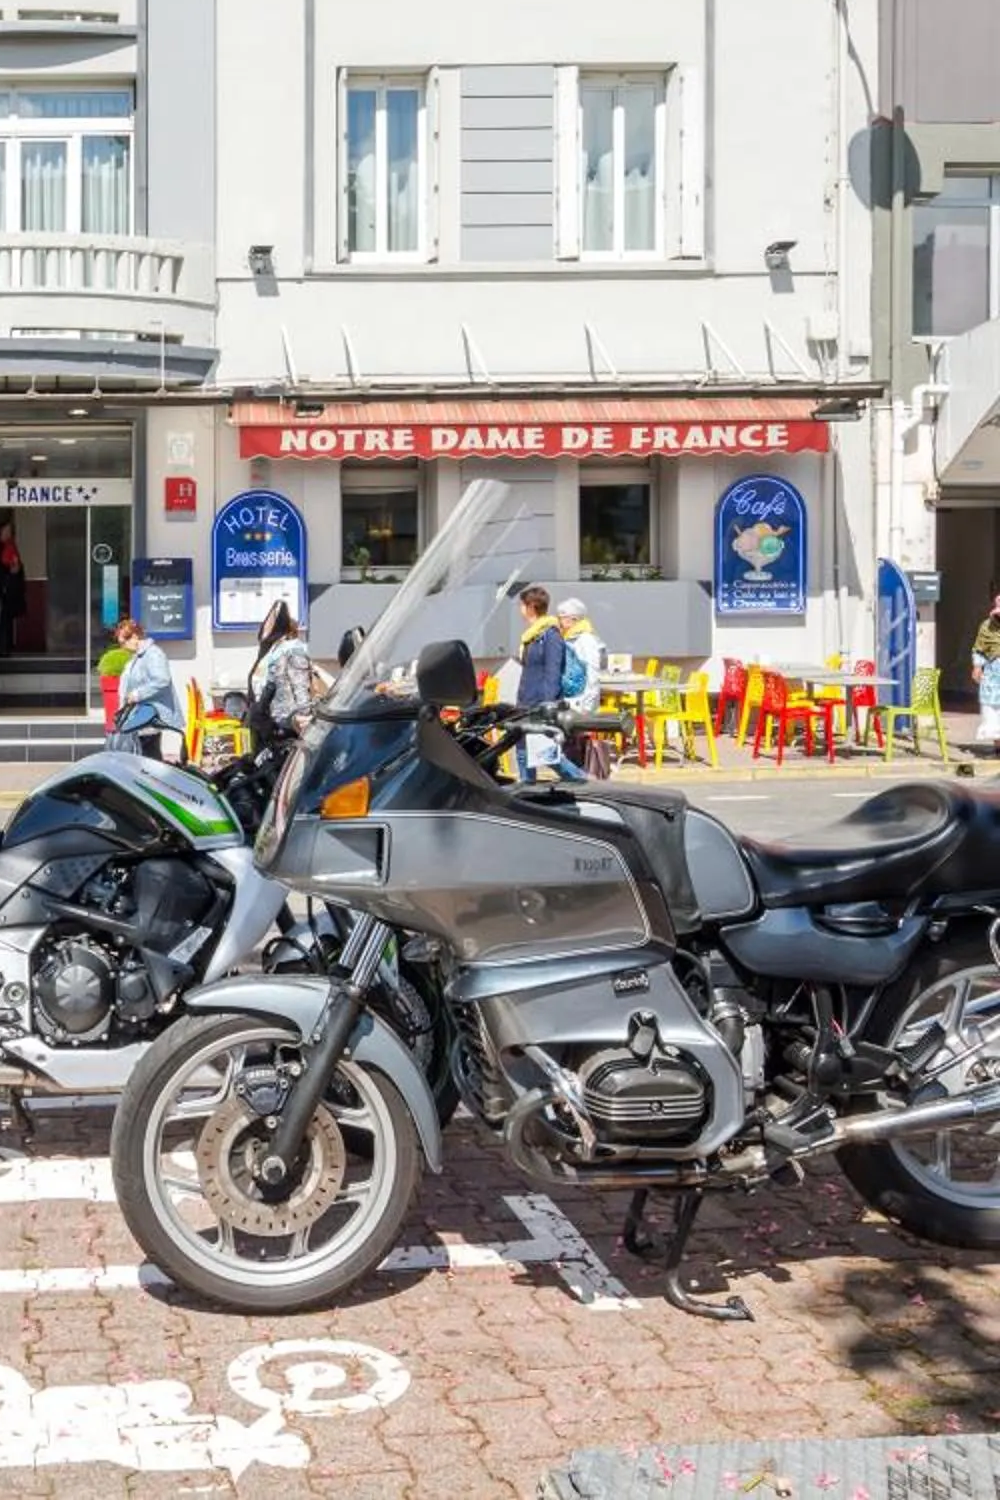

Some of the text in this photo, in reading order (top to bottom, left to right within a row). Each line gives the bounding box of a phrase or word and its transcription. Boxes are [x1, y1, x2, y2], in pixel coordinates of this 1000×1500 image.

[280, 424, 789, 451] NOTRE DAME DE FRANCE
[7, 485, 73, 503] FRANCE
[732, 485, 788, 520] Café
[223, 505, 290, 535] HOTEL
[226, 547, 294, 567] Brasserie
